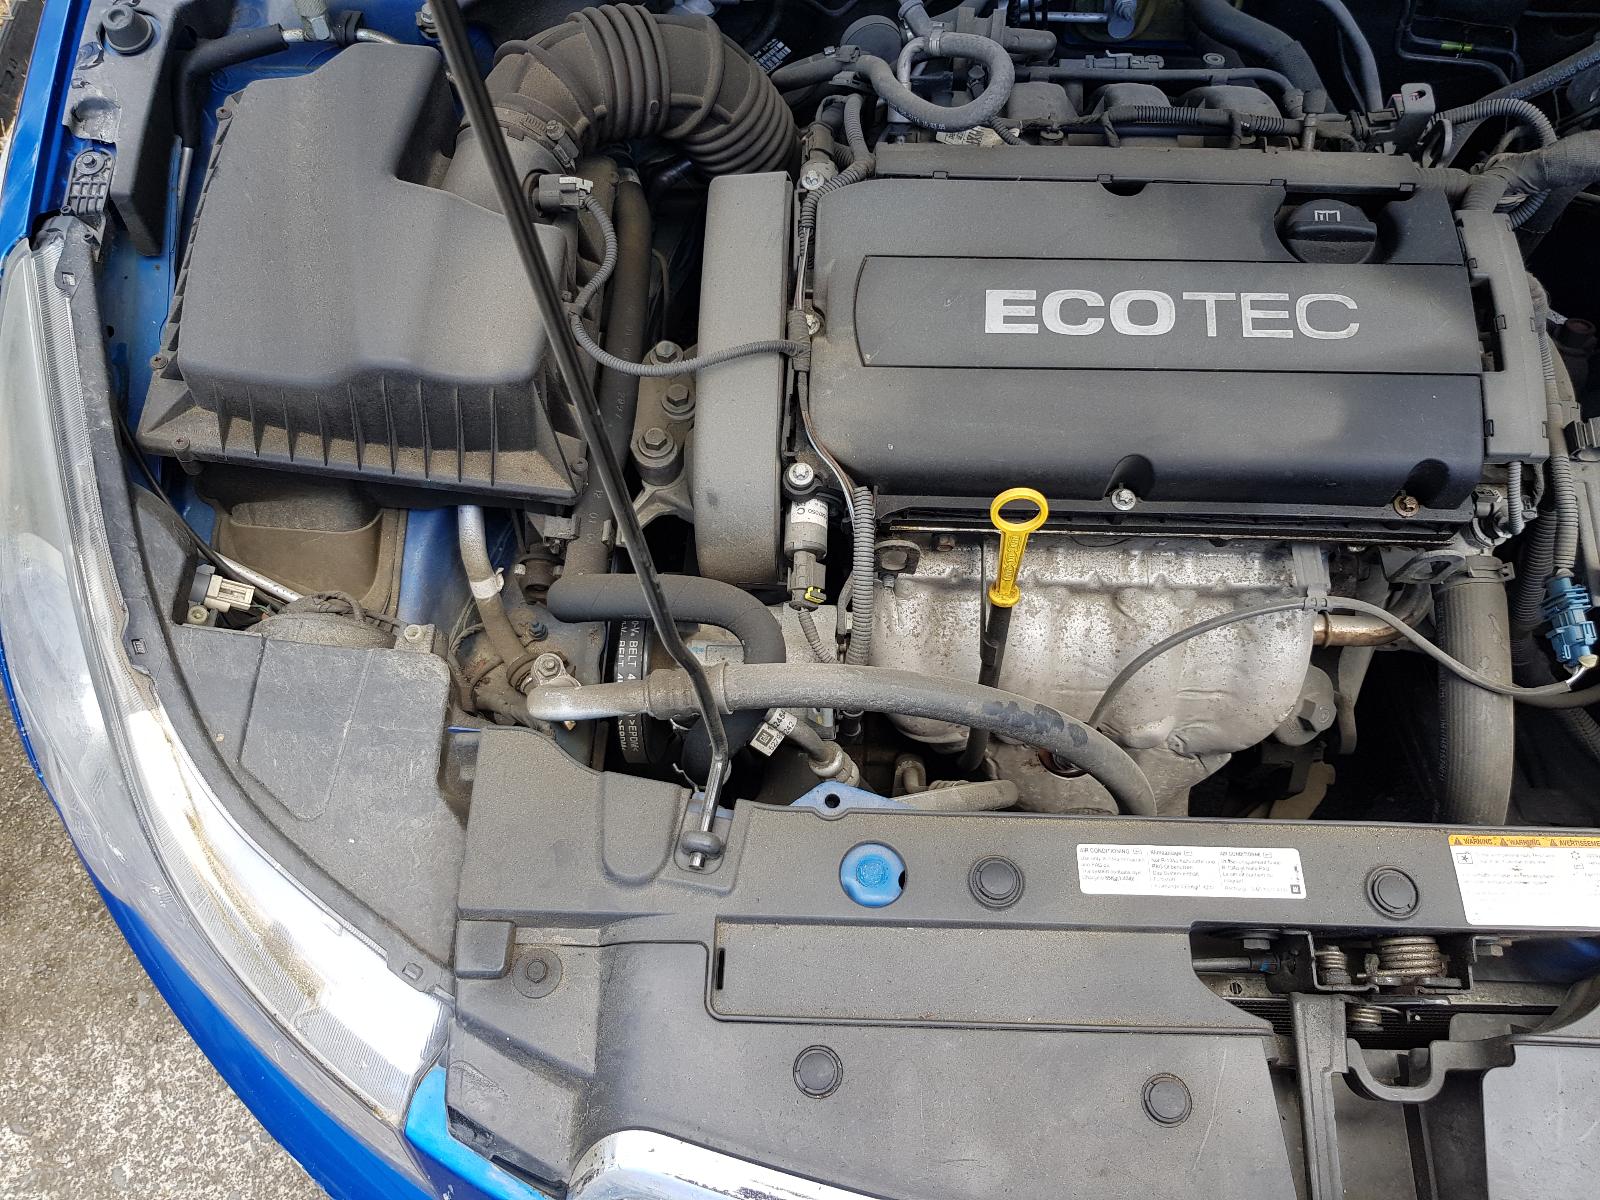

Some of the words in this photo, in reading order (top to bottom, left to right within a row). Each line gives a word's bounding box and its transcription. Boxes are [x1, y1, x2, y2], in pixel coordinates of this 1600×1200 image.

[985, 289, 1360, 340] ECOTEC
[628, 641, 639, 668] BELT
[1463, 838, 1493, 846] WARNING
